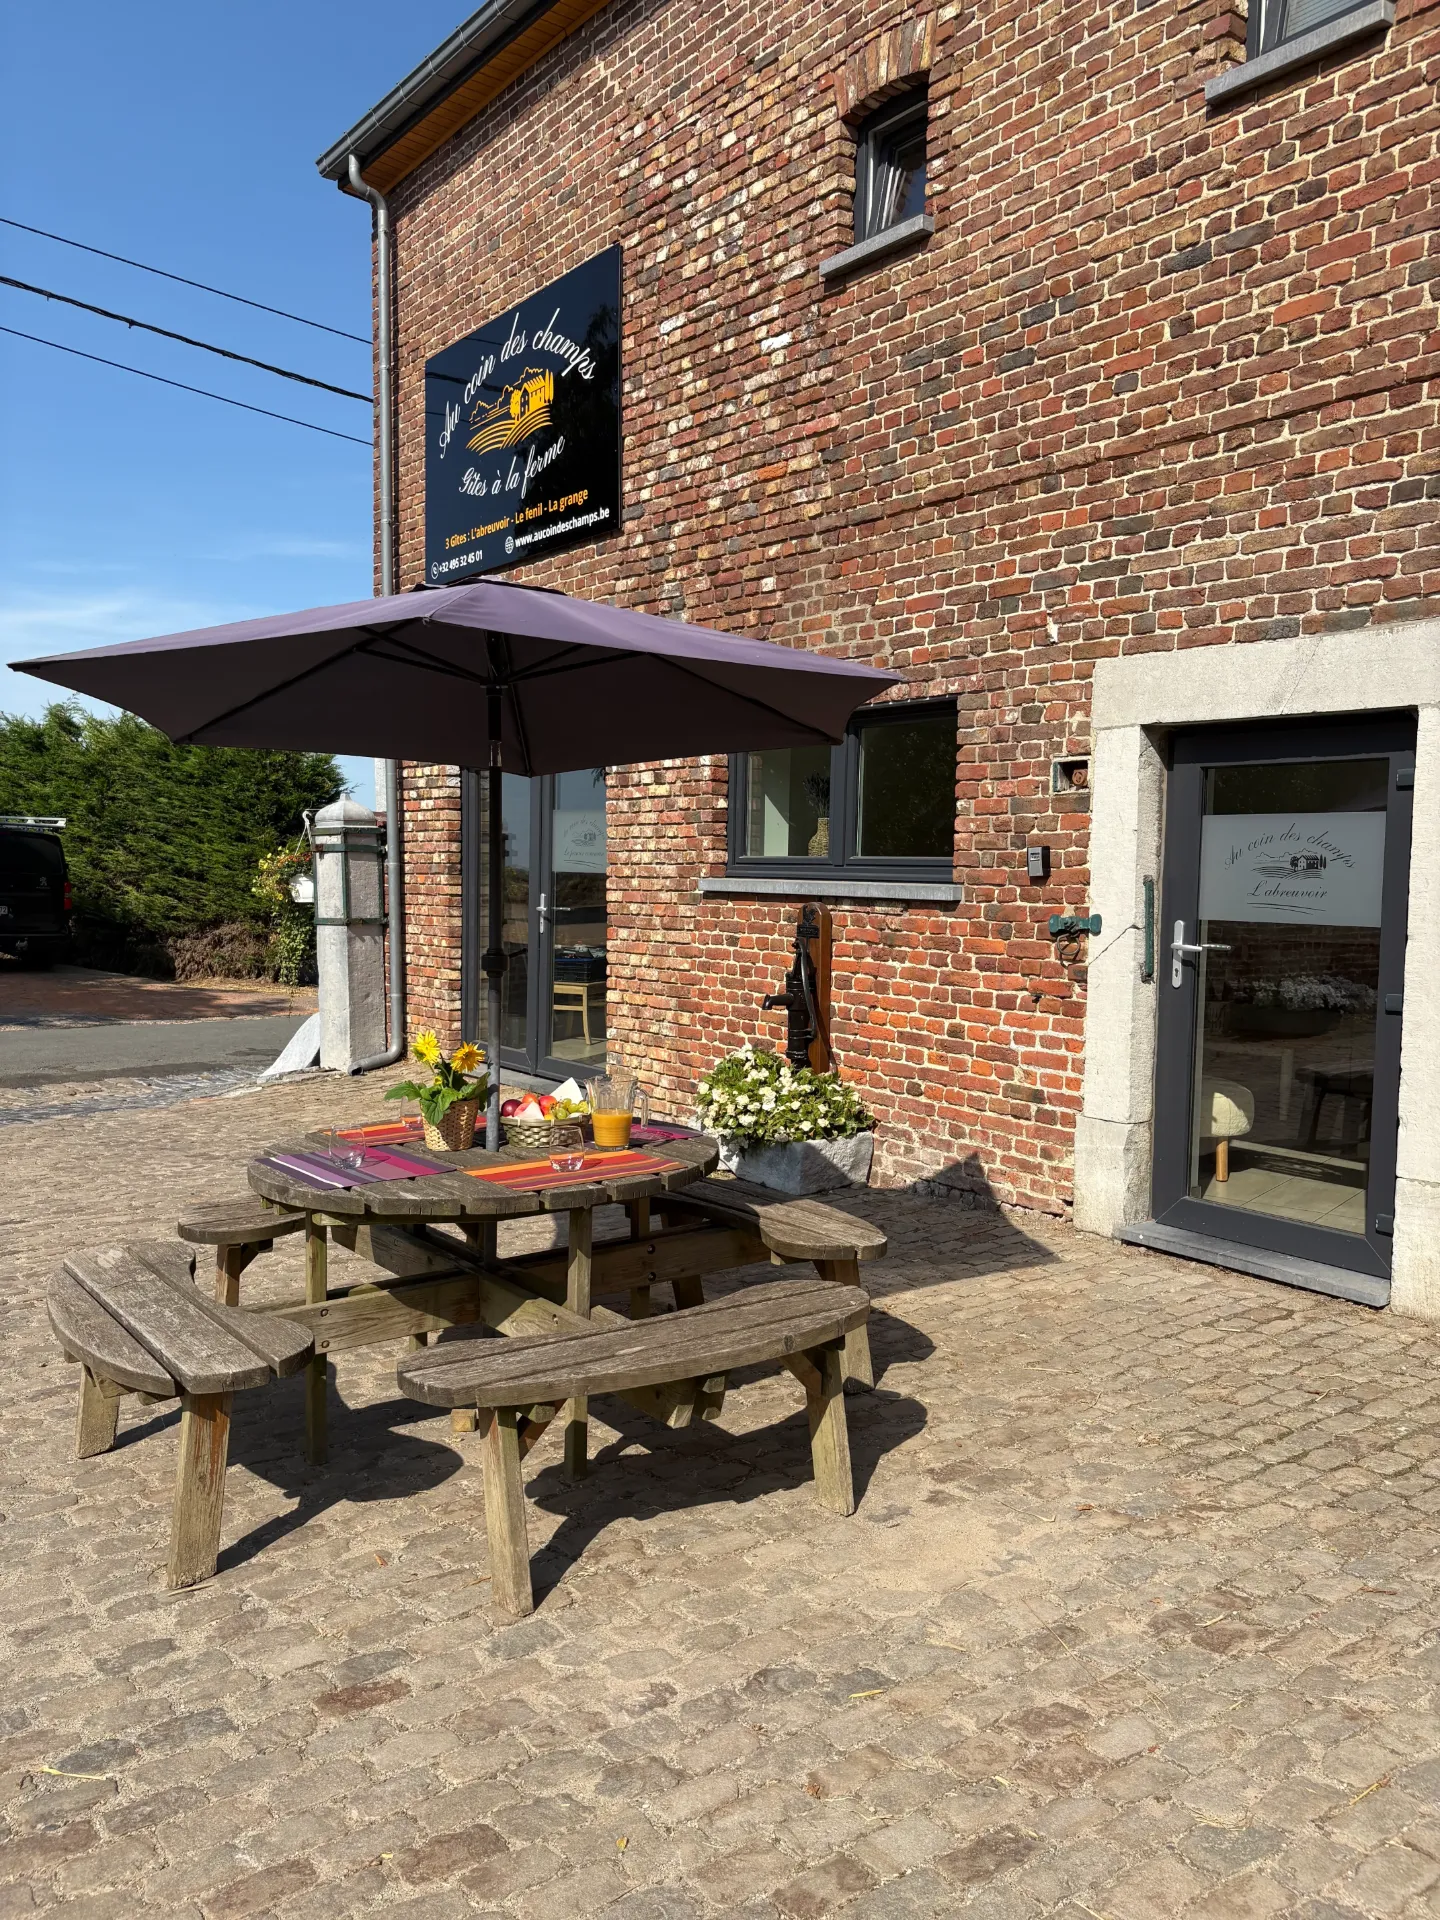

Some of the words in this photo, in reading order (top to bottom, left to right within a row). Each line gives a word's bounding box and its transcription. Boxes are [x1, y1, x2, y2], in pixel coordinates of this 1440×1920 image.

[464, 354, 497, 405] coin
[500, 312, 528, 363] des
[532, 308, 597, 380] champs
[458, 467, 488, 497] Gîtes
[491, 469, 502, 495] à
[505, 456, 520, 492] la
[521, 435, 566, 500] ferme
[445, 538, 450, 550] 3
[450, 532, 467, 549] Gîtes
[471, 517, 510, 540] L'abreuvoir
[515, 512, 524, 525] Le
[525, 503, 543, 521] fenil
[548, 499, 558, 513] La
[559, 489, 589, 512] grange
[515, 507, 610, 548] www.aucoindeschamps.be
[439, 561, 449, 574] +32
[460, 554, 467, 567] 32
[467, 551, 475, 564] 45
[475, 549, 483, 562] 01
[1225, 845, 1244, 870] Au
[1247, 833, 1276, 852] coin
[1279, 822, 1301, 842] des
[1306, 830, 1356, 869] champs
[1246, 880, 1328, 899] L'abreuvoir
